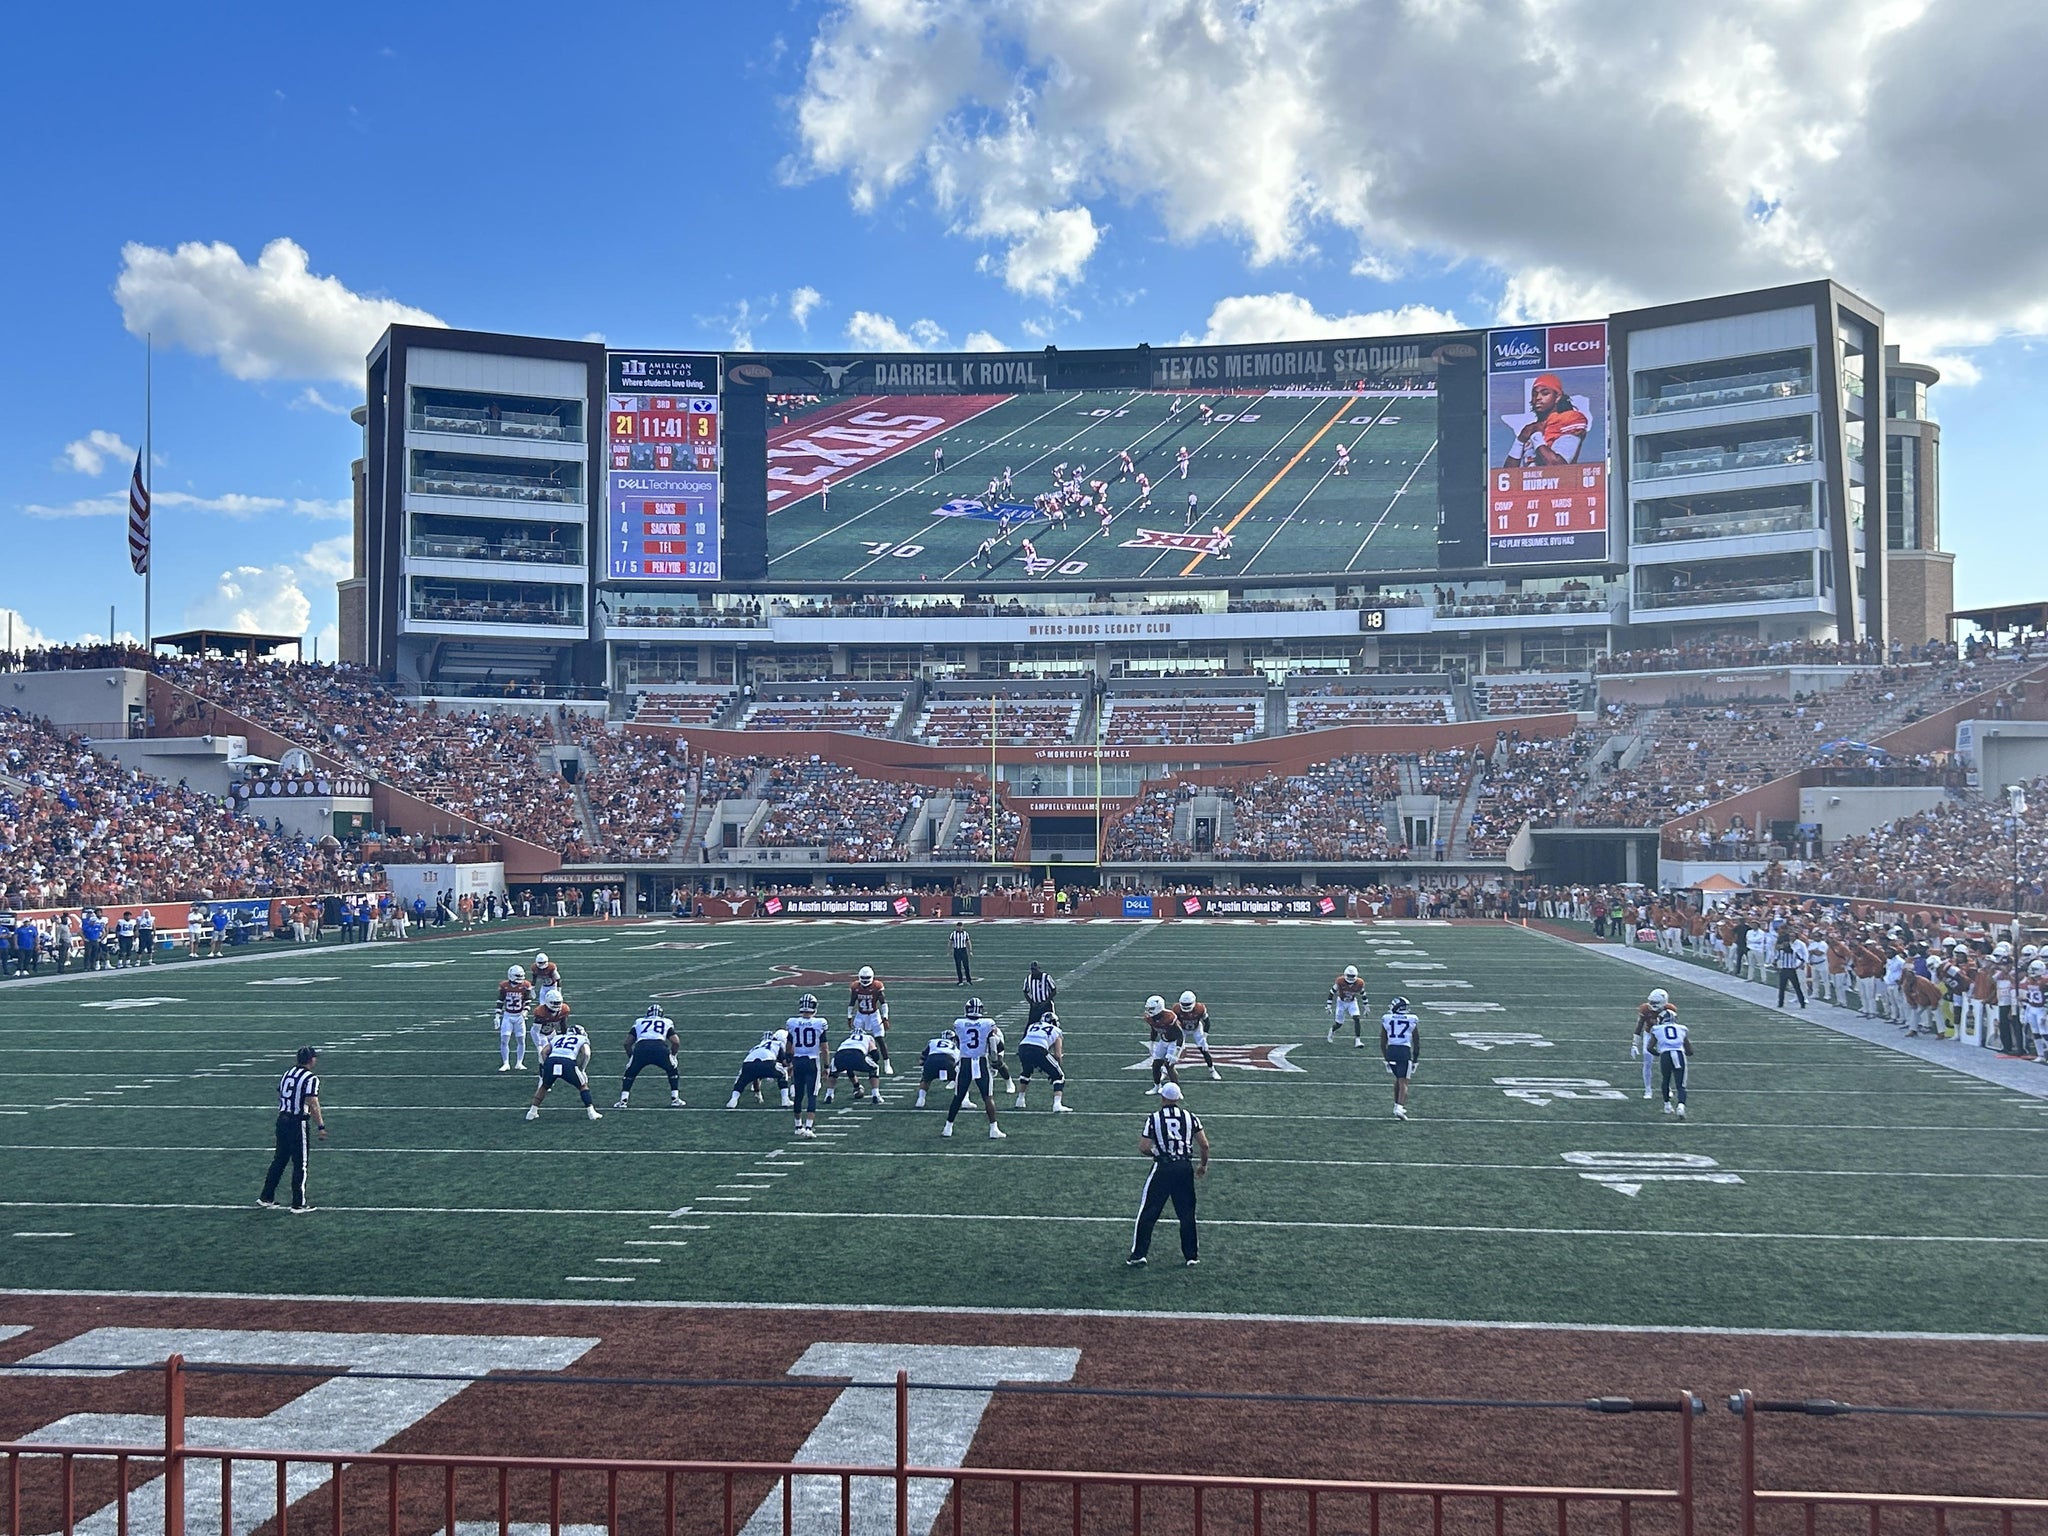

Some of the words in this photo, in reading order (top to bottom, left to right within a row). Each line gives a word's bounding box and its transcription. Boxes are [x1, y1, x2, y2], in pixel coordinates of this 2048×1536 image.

[1494, 337, 1542, 359] WinStar
[1553, 340, 1600, 353] RICOH
[1160, 356, 1219, 381] TEXAS
[1225, 350, 1327, 378] MEMORIAL
[1333, 345, 1420, 372] STADIUM
[875, 363, 956, 386] DARRELL
[962, 363, 974, 386] K
[980, 362, 1037, 385] ROYAL
[622, 378, 643, 387] Where
[644, 379, 671, 388] students
[672, 379, 685, 388] love
[686, 379, 705, 390] living.
[656, 401, 671, 409] 3RD
[616, 415, 632, 435] 21
[642, 417, 682, 437] 11:41
[698, 417, 708, 437] 3
[615, 456, 628, 466] 1ST
[659, 456, 669, 467] 10
[702, 458, 711, 468] 17
[768, 411, 946, 501] EXAS
[1498, 472, 1510, 492] 6
[1522, 477, 1560, 491] MURPHY
[655, 503, 676, 515] SACKS
[698, 502, 704, 515] 1
[1494, 501, 1514, 511] COMP
[1527, 499, 1539, 510] ATT
[1551, 498, 1572, 508] YARDS
[1497, 514, 1508, 529] 11
[1527, 513, 1539, 528] 17
[1554, 511, 1570, 527] 111
[1589, 509, 1596, 525] 1
[621, 521, 628, 534] 4
[651, 522, 667, 535] SACK
[668, 523, 681, 535] YDS
[621, 540, 628, 553] 7
[659, 541, 672, 553] TFL
[697, 541, 704, 554] 2
[1498, 539, 1507, 548] AS
[1507, 538, 1521, 548] PLAY
[1562, 536, 1575, 545] HAS
[1367, 611, 1383, 628] 18
[1105, 623, 1142, 634] LEGACY
[1147, 623, 1171, 633] CLUB
[1047, 750, 1087, 758] MONCRIEF
[1093, 750, 1130, 758] COMPLEX
[543, 874, 575, 882] SMOKEY
[576, 874, 592, 882] THE
[593, 873, 625, 882] CANNON
[787, 901, 797, 912] An
[798, 901, 820, 912] Austin
[821, 901, 848, 913] Original
[849, 901, 869, 912] Since
[870, 901, 887, 912] 1983
[1126, 900, 1149, 909] DELL
[1242, 901, 1269, 913] Original
[1293, 901, 1311, 912] 1983
[505, 995, 523, 1010] 23
[859, 1002, 873, 1012] 41
[640, 1020, 665, 1035] 78
[1388, 1020, 1410, 1039] 17
[1664, 1026, 1678, 1040] 0
[553, 1037, 579, 1050] 42
[794, 1027, 817, 1048] 10
[966, 1028, 979, 1049] 3
[282, 1077, 295, 1098] C
[1164, 1118, 1182, 1140] R
